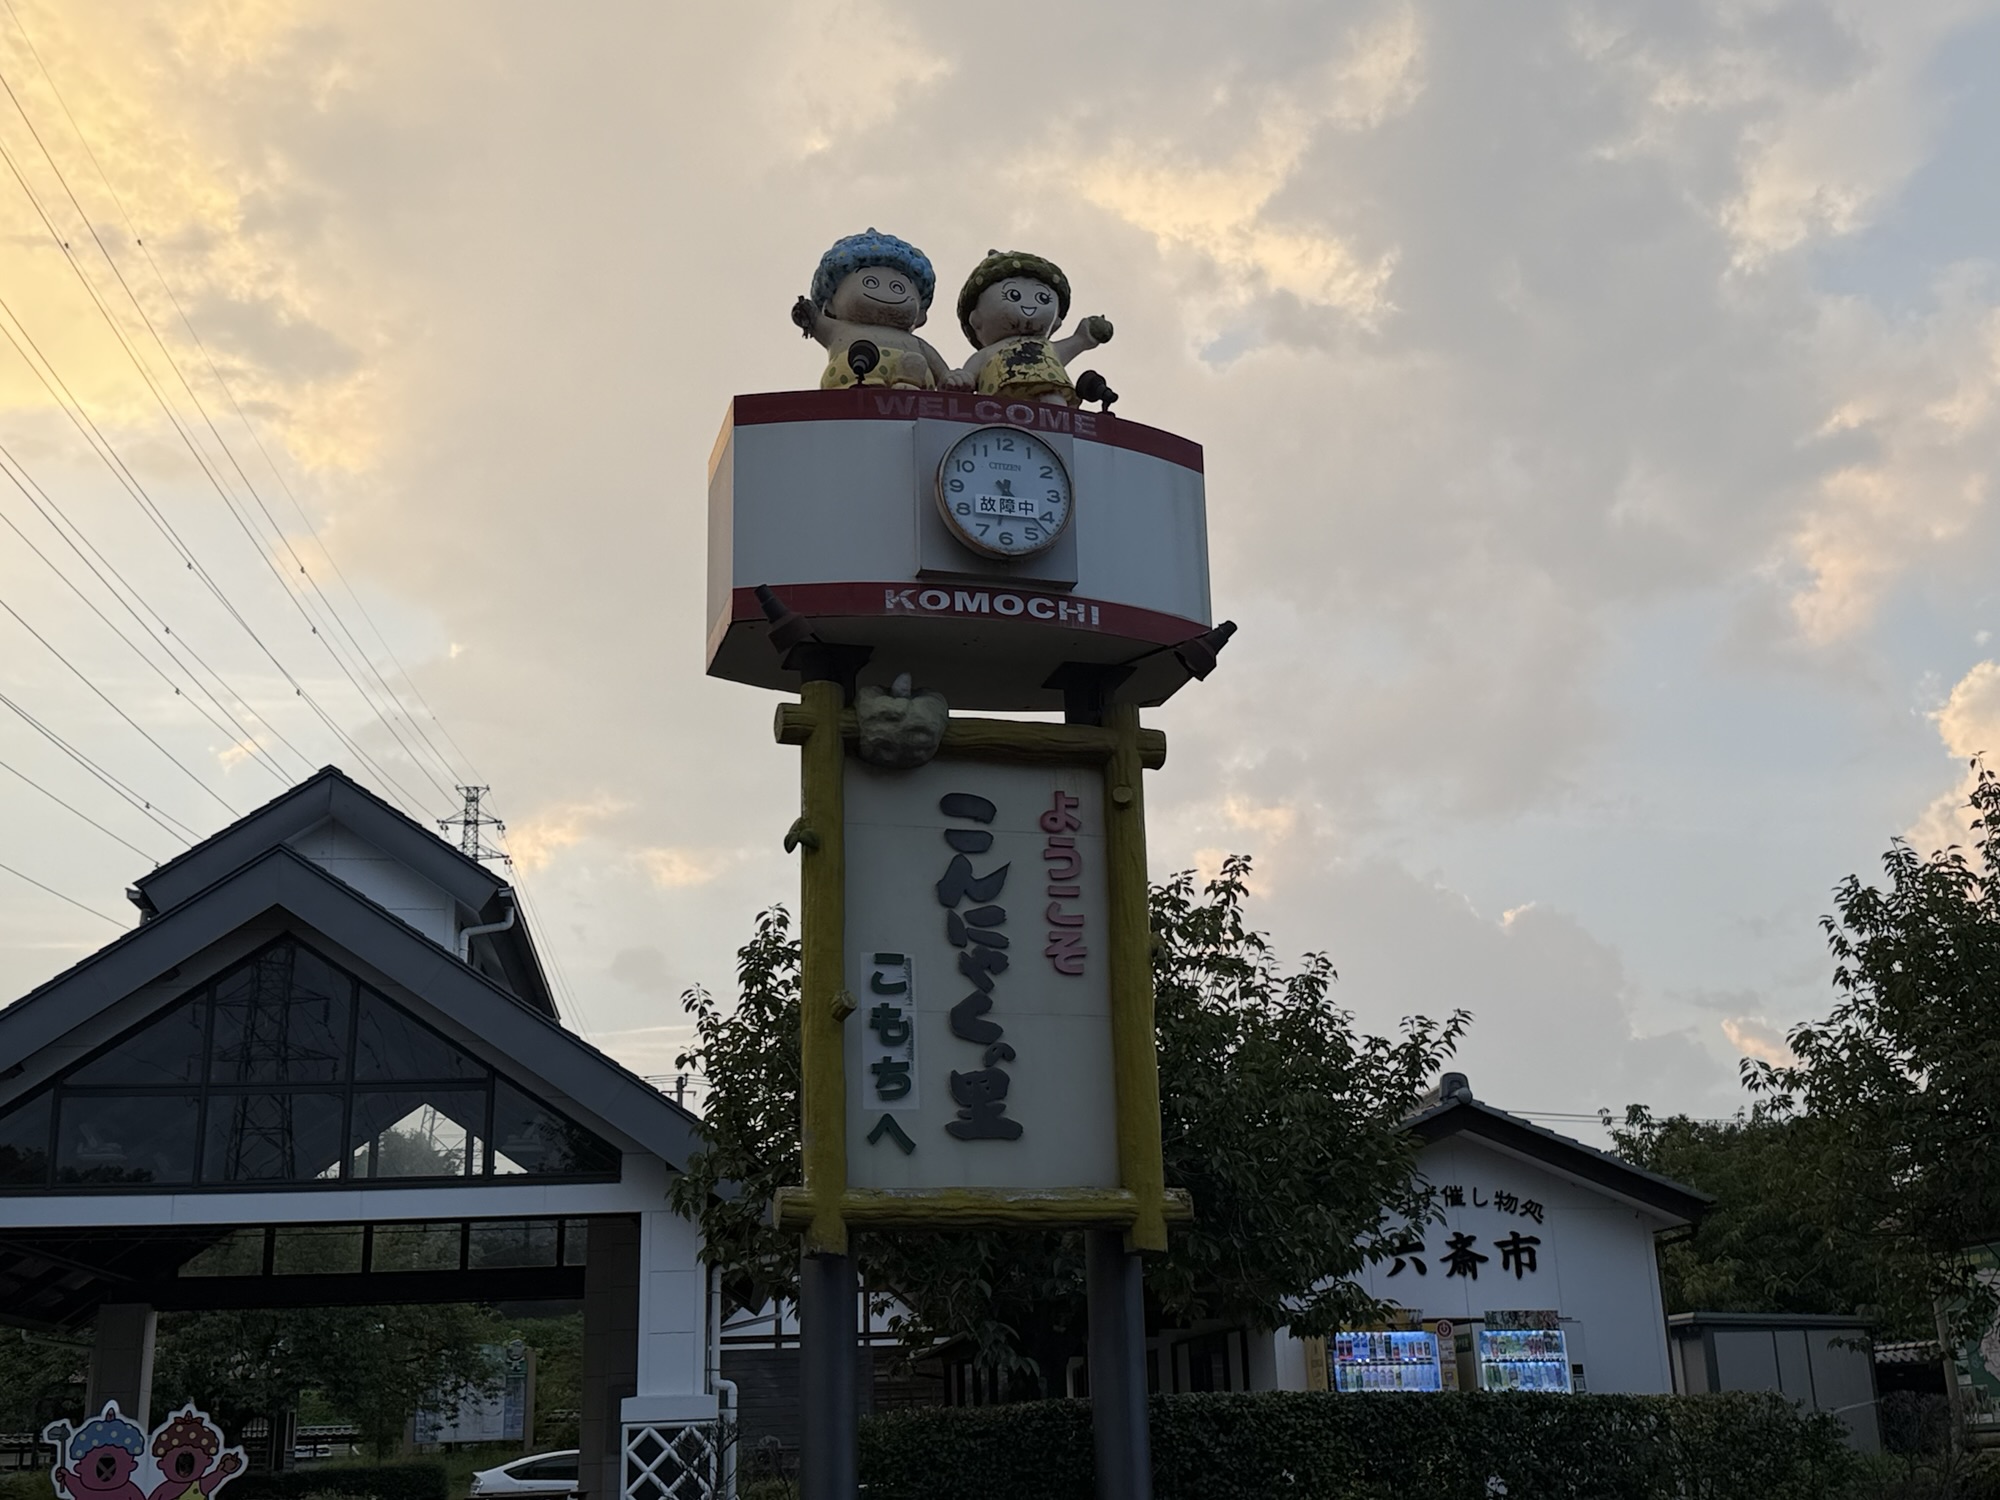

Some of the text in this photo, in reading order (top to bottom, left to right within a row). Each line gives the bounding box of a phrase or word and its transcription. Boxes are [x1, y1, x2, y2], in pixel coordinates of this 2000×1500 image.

[873, 394, 1097, 437] WELCOME
[971, 444, 988, 457] 11
[996, 438, 1014, 452] 12
[1025, 447, 1032, 459] 1
[956, 459, 975, 473] 10
[988, 461, 1022, 472] CITIZEN
[1039, 466, 1053, 480] 2
[949, 479, 964, 492] 9
[1046, 490, 1061, 503] 3
[956, 502, 971, 516] 8
[980, 496, 1034, 516] 故障中
[1039, 511, 1055, 524] 4
[975, 523, 990, 537] 7
[1024, 527, 1039, 541] 5
[998, 531, 1013, 546] 6
[884, 588, 1100, 626] KOMOCHI
[1039, 790, 1089, 976] ようこそ
[936, 792, 1025, 1141] こんにゃくの里
